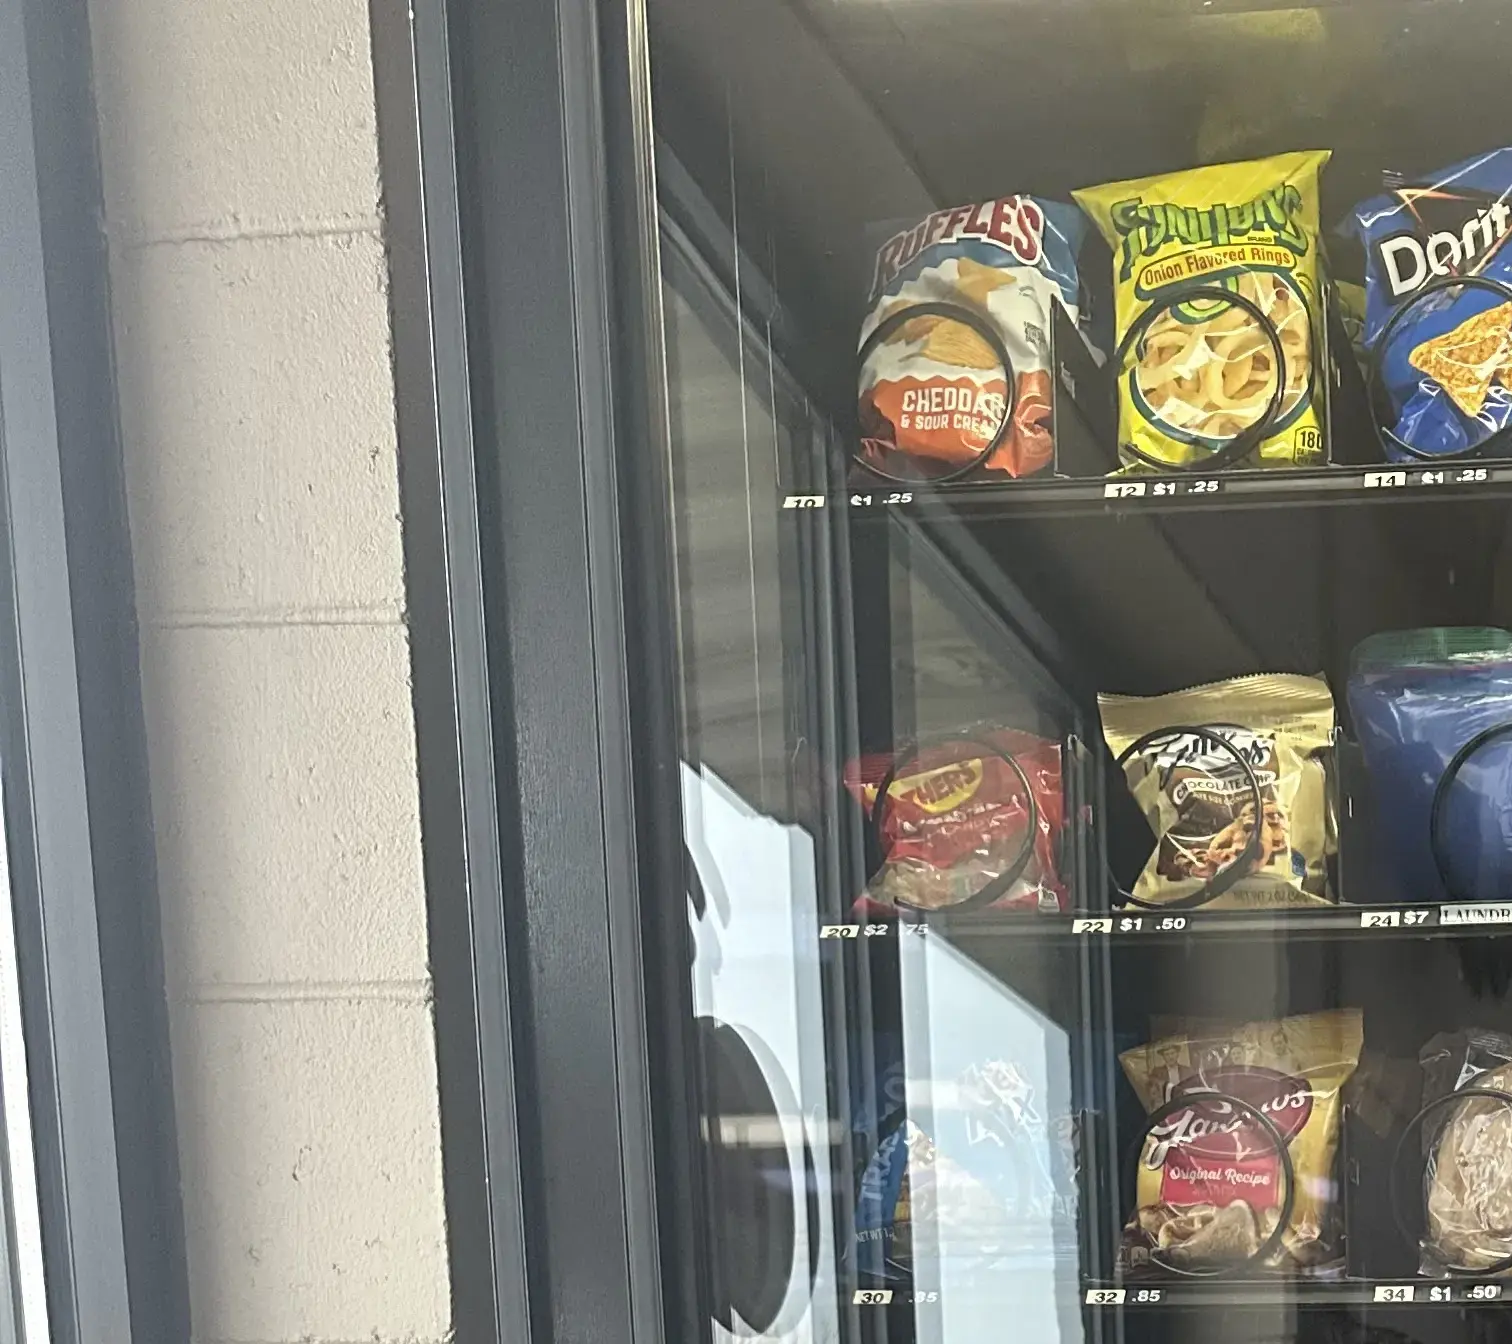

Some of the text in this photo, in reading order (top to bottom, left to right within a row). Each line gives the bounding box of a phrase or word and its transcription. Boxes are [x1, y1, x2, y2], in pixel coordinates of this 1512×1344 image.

[872, 195, 1043, 292] RUFFLES
[1144, 245, 1292, 287] Onion Flavored Rings
[902, 388, 1006, 415] CHEDDAR
[900, 413, 949, 429] & SOUR
[1119, 917, 1186, 931] $1 .50
[1169, 1167, 1271, 1187] Original Recipe
[1094, 1289, 1161, 1304] 32 .85
[1383, 1283, 1498, 1302] 34 $1 .50
